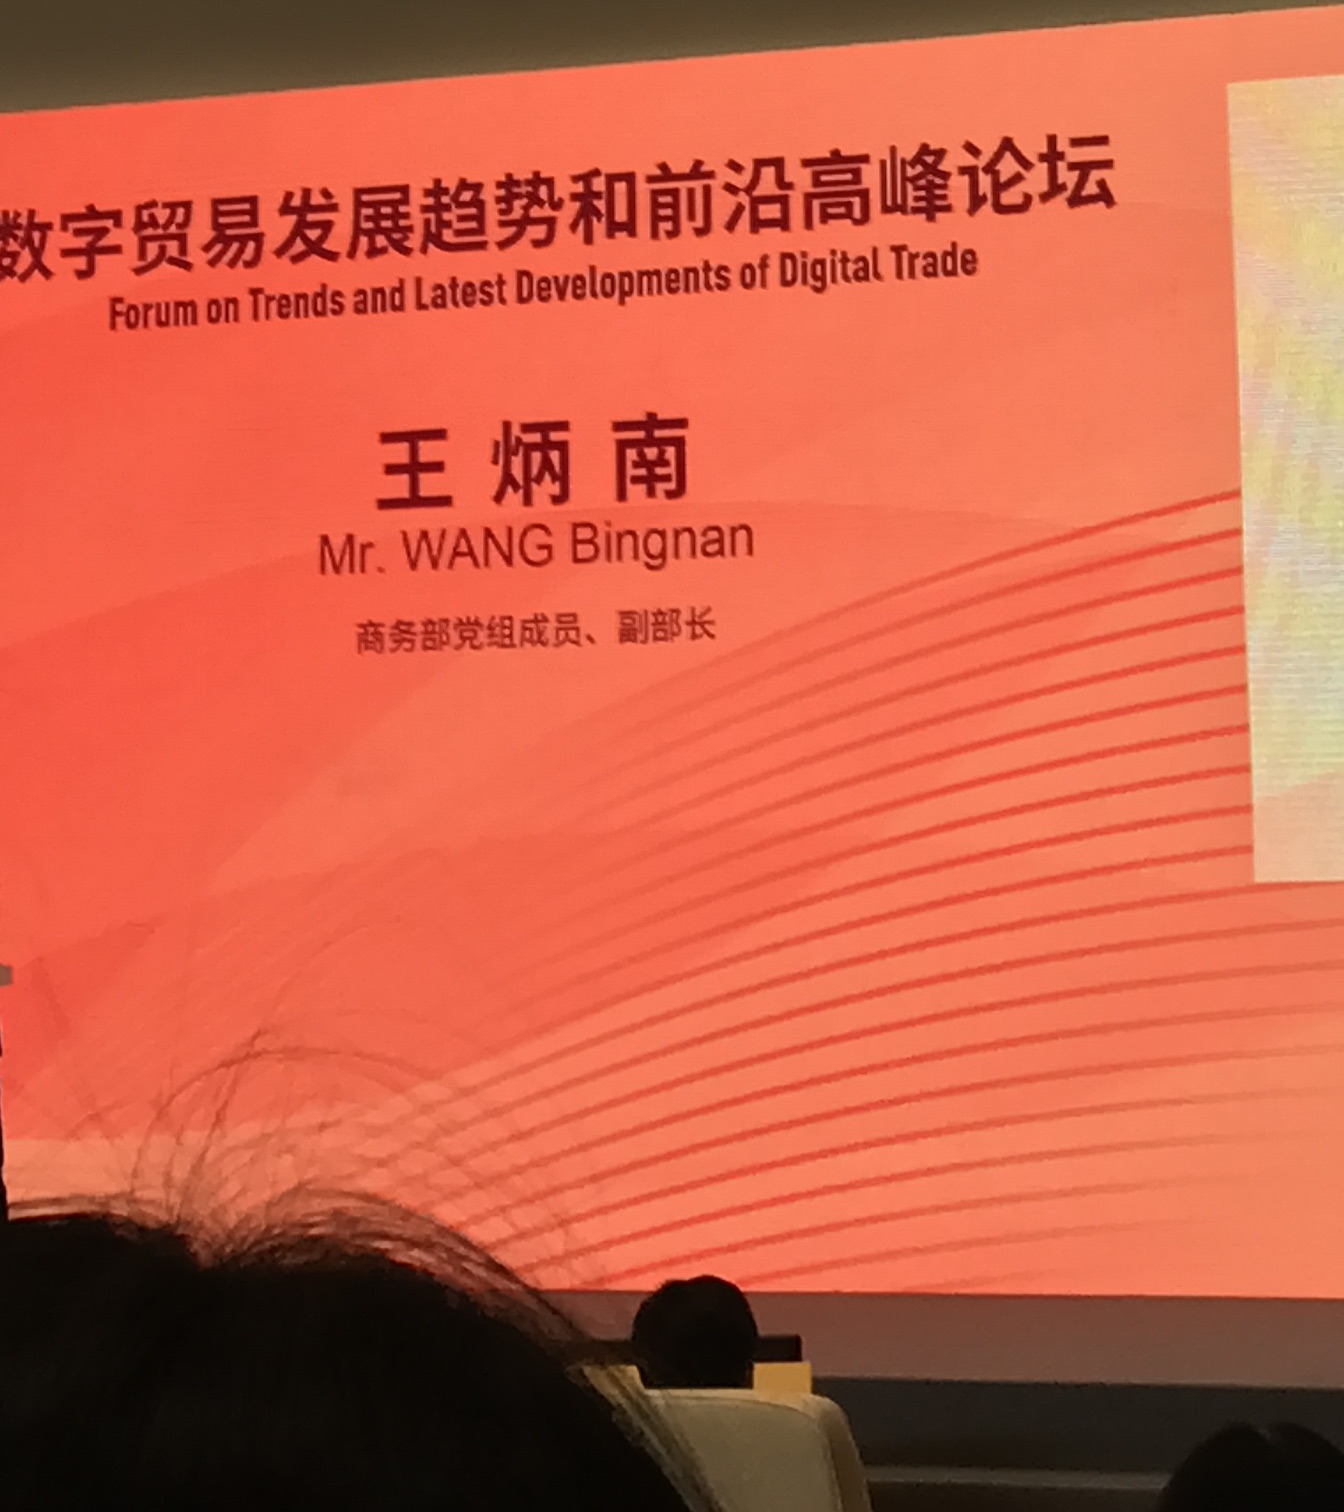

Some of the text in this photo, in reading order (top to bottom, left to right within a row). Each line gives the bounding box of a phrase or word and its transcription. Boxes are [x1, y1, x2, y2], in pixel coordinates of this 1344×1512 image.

[108, 241, 979, 332] Forum on Trends and Latest Developments of Digital Trade
[318, 520, 754, 576] Mr. WANG Bingnan
[356, 606, 716, 655] 商务部党组成员、副部长
